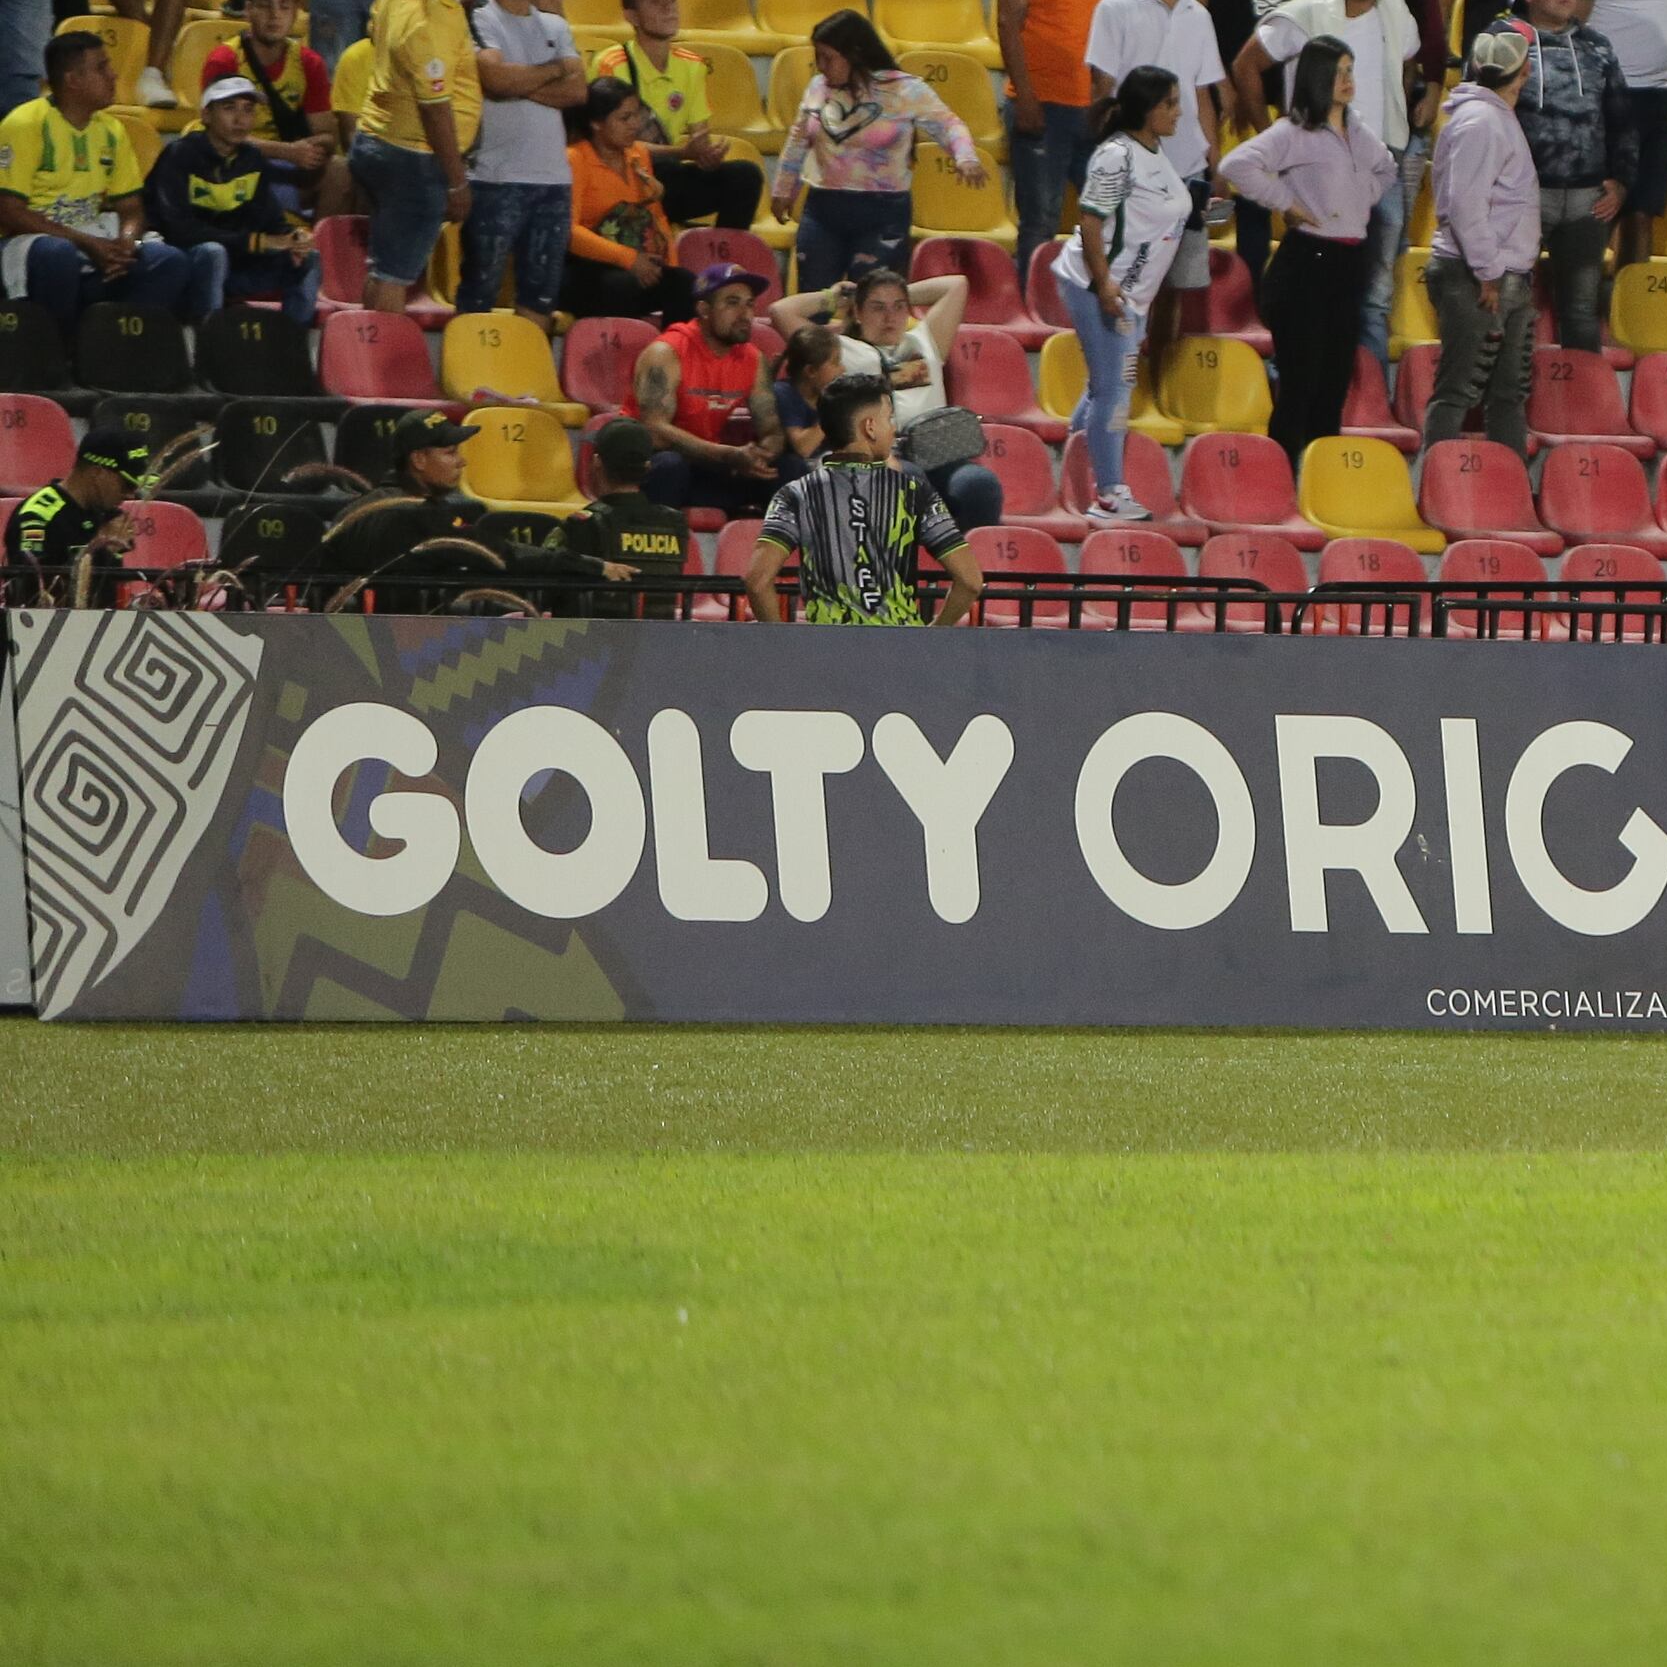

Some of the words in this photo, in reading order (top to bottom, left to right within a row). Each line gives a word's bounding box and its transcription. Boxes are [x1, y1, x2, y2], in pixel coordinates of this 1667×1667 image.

[117, 316, 143, 336] 10
[240, 321, 262, 341] 11
[357, 325, 379, 344] 12
[477, 328, 501, 348] 13
[1195, 350, 1219, 370] 19
[1550, 362, 1574, 381] 22
[253, 415, 278, 435] 10
[501, 423, 526, 442] 12
[1217, 448, 1240, 468] 18
[1341, 450, 1364, 469] 19
[1578, 458, 1602, 477] 21
[620, 532, 682, 555] POLICIA
[995, 541, 1019, 559] 15
[849, 496, 882, 611] STAFF
[1117, 544, 1141, 563] 16
[1237, 549, 1260, 569] 17
[1357, 553, 1381, 572] 18
[1478, 556, 1501, 575] 19
[1595, 558, 1617, 577] 20
[282, 701, 1016, 925] GOLTY
